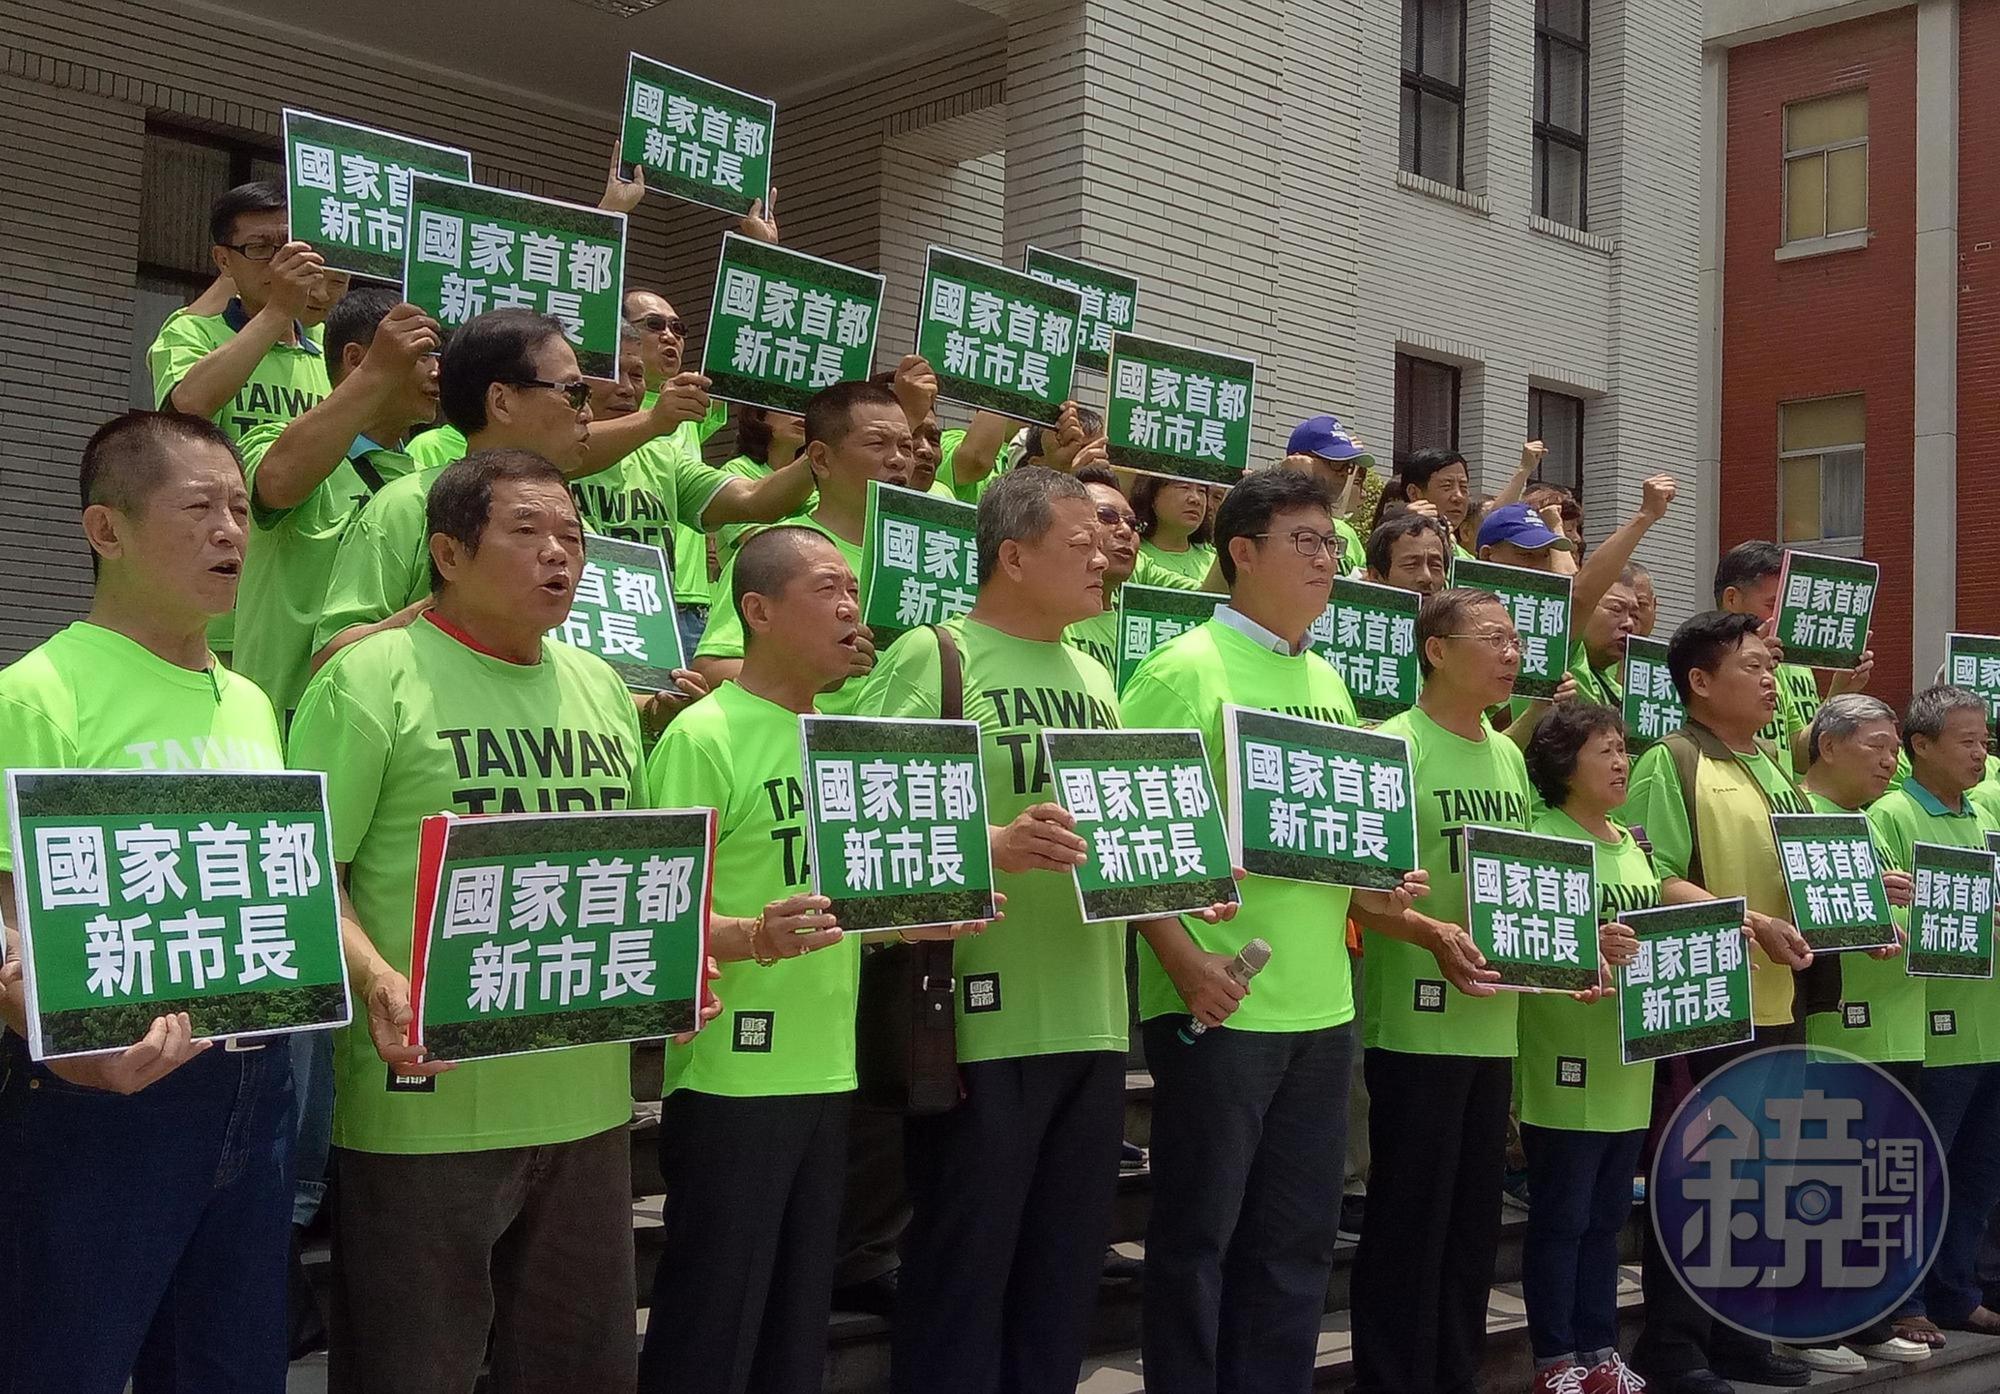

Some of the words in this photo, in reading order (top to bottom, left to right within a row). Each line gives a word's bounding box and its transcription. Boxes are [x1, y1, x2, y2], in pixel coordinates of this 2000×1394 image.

[631, 80, 766, 159] 國家首都
[294, 141, 409, 207] 國家首
[643, 127, 744, 193] 新市長
[319, 196, 404, 254] 新市
[417, 210, 614, 295] 國家首都
[719, 266, 872, 349] 國家首都
[928, 277, 1074, 358] 國家首都
[1030, 269, 1131, 325] 首都
[731, 324, 844, 389] 新市長
[943, 330, 1050, 398] 新市長
[235, 382, 325, 418] TAIW
[1115, 358, 1248, 423] 國家首都
[1127, 404, 1228, 462] 新市長
[1784, 573, 1873, 618] 國家首都
[1310, 603, 1415, 657] 國家首都
[1791, 611, 1857, 650] 新市長
[981, 687, 1118, 730] TAIWAN
[1629, 660, 1681, 703] 國家
[437, 728, 632, 779] TAIWAN
[1245, 742, 1406, 809] 國家首都
[813, 758, 978, 822] 國家首都
[1058, 763, 1212, 823] 國家首都
[843, 826, 965, 891] 新市長
[1095, 820, 1207, 884] 新市長
[1268, 797, 1390, 863] 新市長
[1781, 838, 1876, 883] 國家首都
[33, 819, 321, 911] 國家首都
[1472, 856, 1591, 917] 國家首都
[1914, 868, 1991, 915] 國家首都
[442, 854, 696, 940] 國家首都
[1805, 882, 1878, 926] 新市長
[84, 904, 299, 998] 新市長
[1491, 909, 1580, 965] 新市長
[1626, 927, 1743, 988] 國家首都
[1920, 911, 1979, 954] 新市長
[466, 929, 657, 1013] 新市長
[1641, 975, 1732, 1032] 新市長
